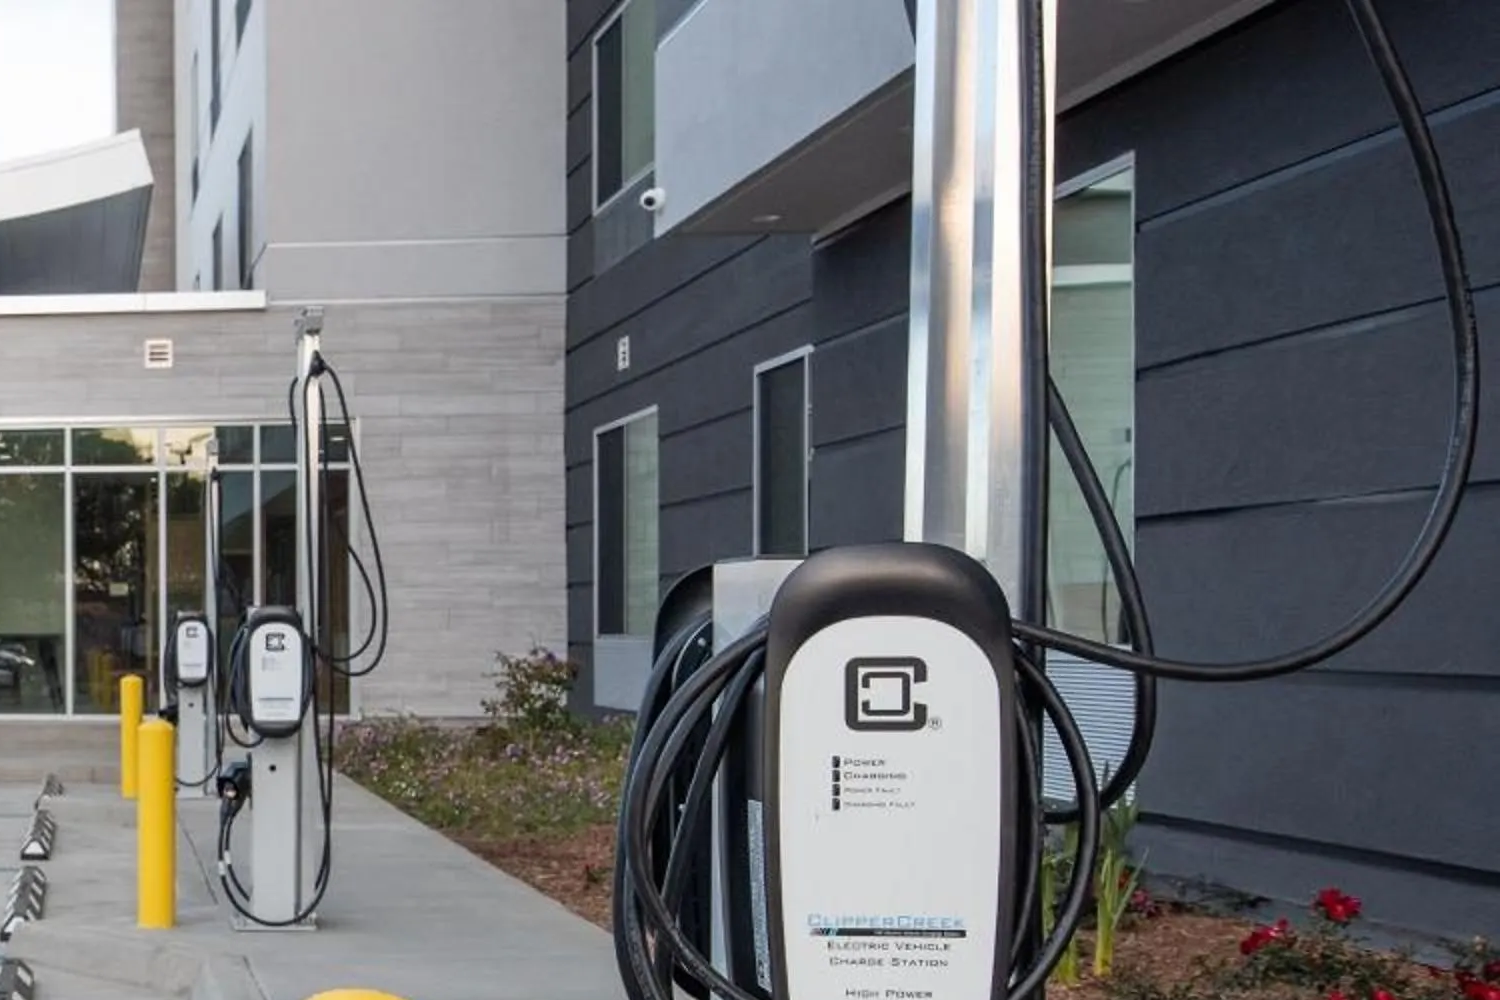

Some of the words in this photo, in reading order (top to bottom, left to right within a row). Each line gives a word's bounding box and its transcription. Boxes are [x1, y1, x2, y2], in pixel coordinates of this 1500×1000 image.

[895, 941, 952, 951] VEHICLE
[829, 956, 884, 967] CHARGE
[891, 956, 949, 968] STATION
[845, 987, 880, 998] HIGH
[884, 988, 934, 999] POWER
